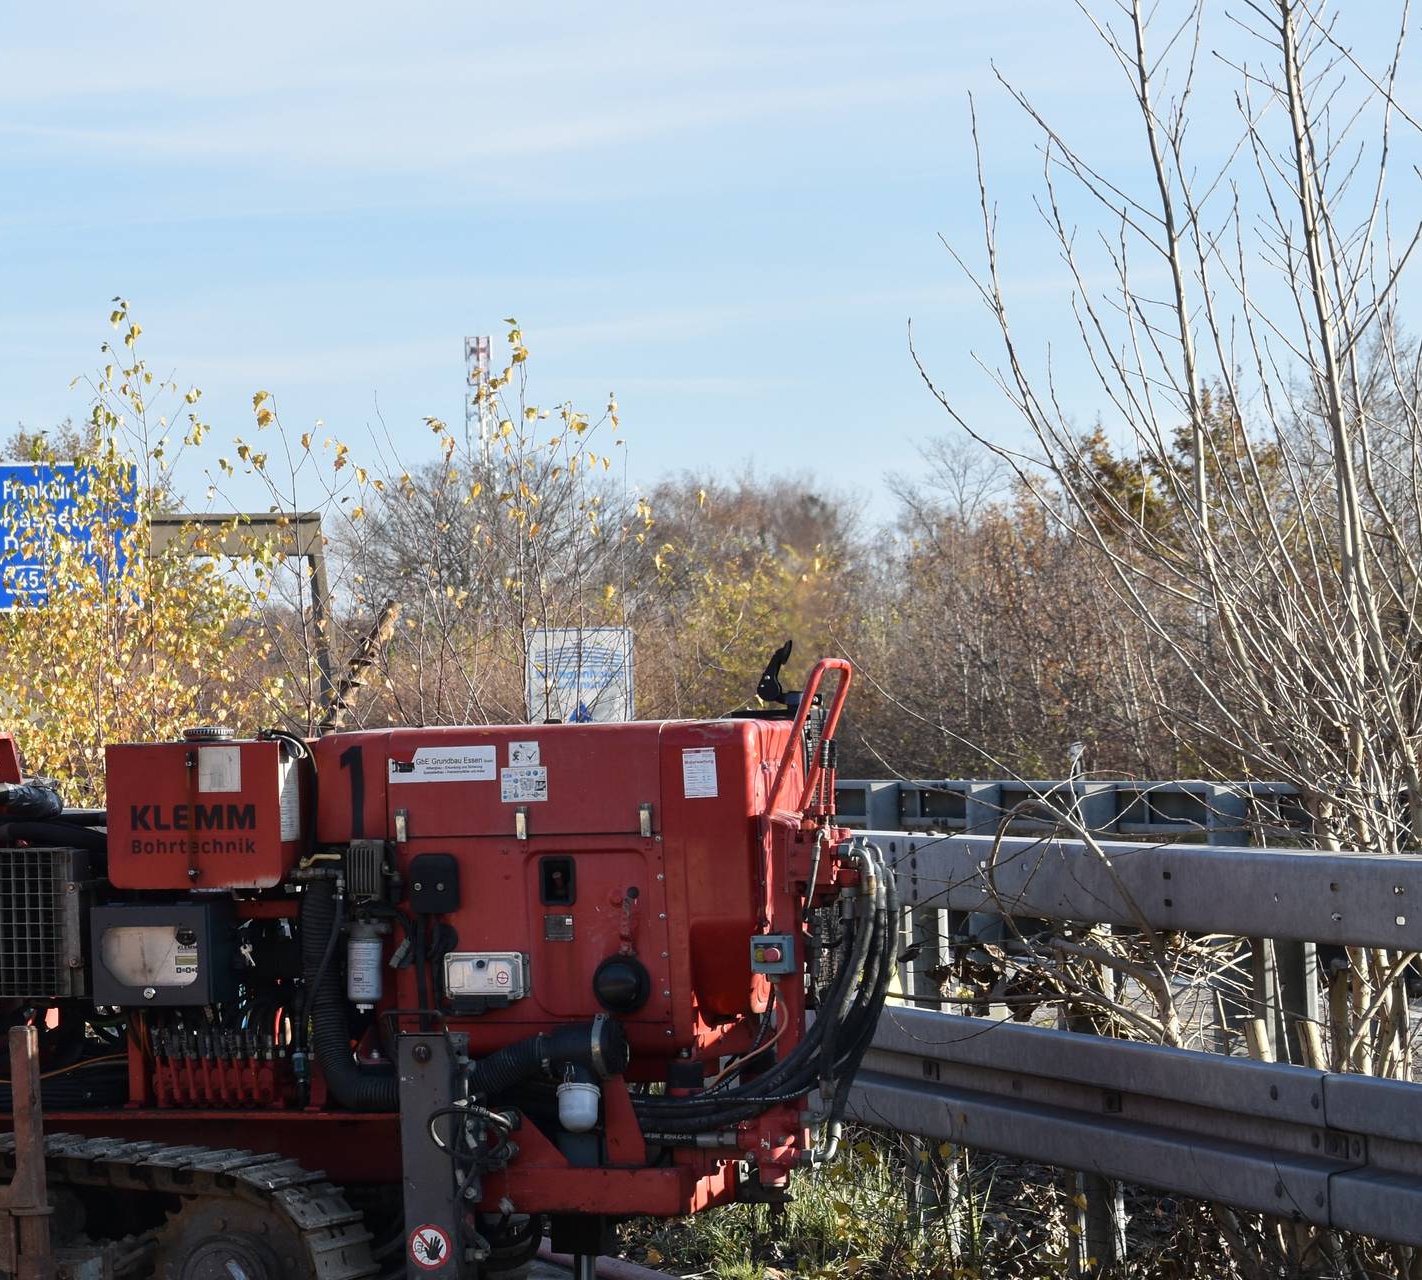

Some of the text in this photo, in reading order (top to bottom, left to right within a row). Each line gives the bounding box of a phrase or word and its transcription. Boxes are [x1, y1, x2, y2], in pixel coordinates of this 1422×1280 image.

[431, 757, 463, 765] Grundbau
[463, 756, 483, 764] Essen
[340, 745, 365, 840] 1
[130, 804, 256, 831] KLEMM
[131, 839, 256, 854] Bohrtechnik
